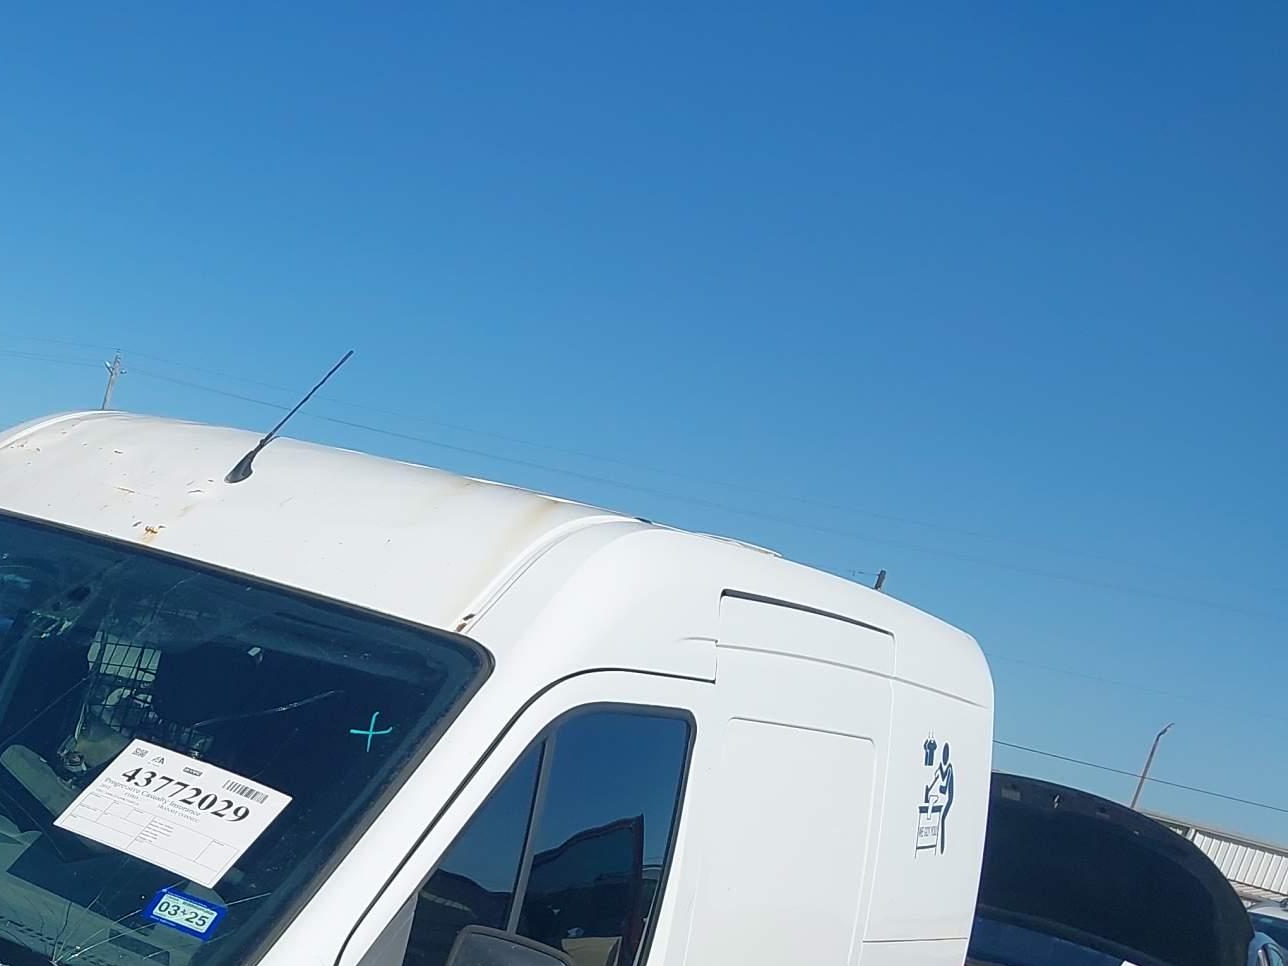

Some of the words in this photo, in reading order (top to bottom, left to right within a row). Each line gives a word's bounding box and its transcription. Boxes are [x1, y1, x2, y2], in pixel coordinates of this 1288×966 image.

[122, 767, 250, 823] 43772029
[158, 901, 180, 916] 03
[185, 911, 209, 927] 25
